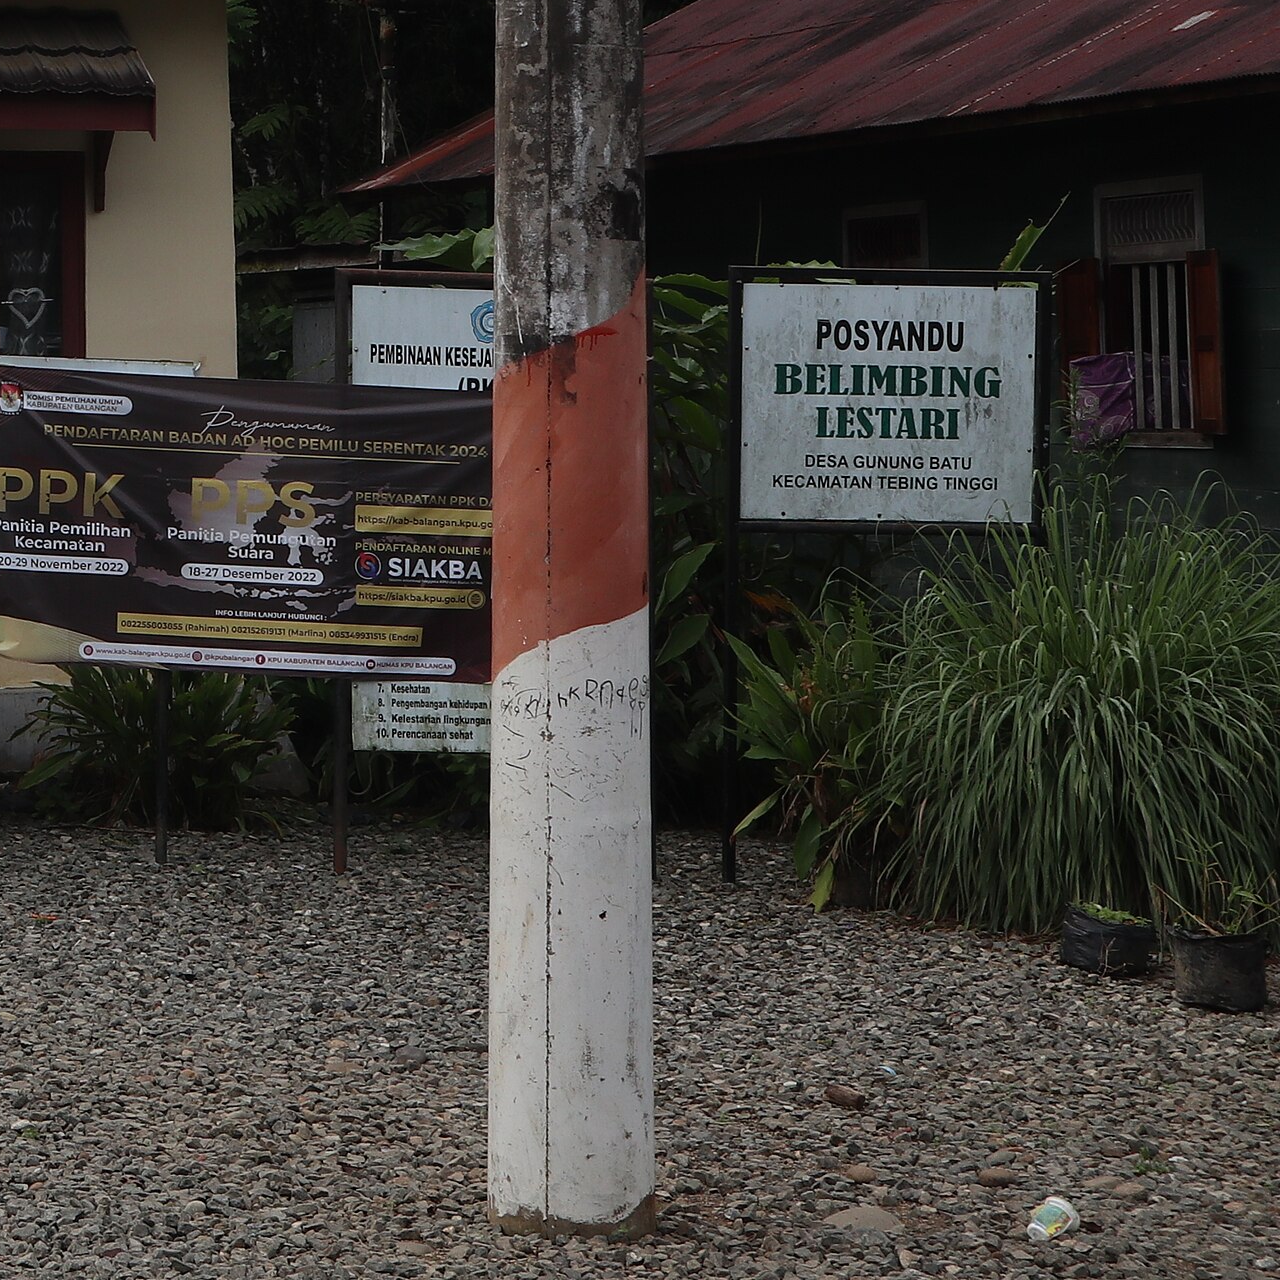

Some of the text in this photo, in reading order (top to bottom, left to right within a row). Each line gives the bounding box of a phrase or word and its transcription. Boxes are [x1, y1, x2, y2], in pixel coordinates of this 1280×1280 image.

[816, 319, 965, 352] POSYANDU
[370, 344, 441, 366] PEMBINAAN
[774, 363, 1002, 398] BELIMBING
[27, 393, 123, 406] KOMISI PEMILIHAN UMUM
[27, 400, 118, 413] KABUPATEN BALANGAN
[200, 405, 335, 439] Pengumuman
[815, 406, 961, 440] LESTARI
[44, 424, 489, 458] PENDAFTARAN BADAN AD HOC PEMILU SERENTAK 2024
[804, 454, 972, 470] DESA GUNUNG BATU
[772, 475, 998, 491] KECAMATAN TEBING TINGGI
[192, 477, 316, 528] PPS
[355, 492, 446, 505] PERSYARATAN
[450, 496, 476, 506] PPK
[50, 521, 131, 538] Pemilihan
[167, 527, 336, 548] Panitia Pemungutan
[15, 535, 105, 552] Kecamatan
[355, 542, 436, 554] PENDAFTARAN
[439, 545, 481, 556] ONLINE
[228, 545, 274, 560] Suara
[30, 558, 91, 572] November
[94, 561, 123, 573] 2022
[388, 557, 483, 580] SIAKBA
[188, 566, 317, 582] 18-27 Desember 2022
[358, 591, 466, 604] https://siakba.kpu.go.id
[215, 609, 233, 617] INFO
[235, 610, 257, 618] LEBIH
[258, 611, 286, 619] LANJUT
[185, 622, 229, 634] (Rahimah)
[288, 628, 327, 638] (Marlina)
[388, 633, 418, 643] (Endra)
[204, 653, 254, 663] @kpubalangan
[283, 658, 326, 666] KABUPATEN
[327, 659, 365, 667] BALANGAN
[377, 683, 430, 694] 7. Kesehatan
[378, 698, 487, 711] 8. Pengembangan kehidupan
[378, 714, 491, 726] 9. Kelestarian lingkungan
[376, 729, 474, 740] 10. Perencanaan sehat
